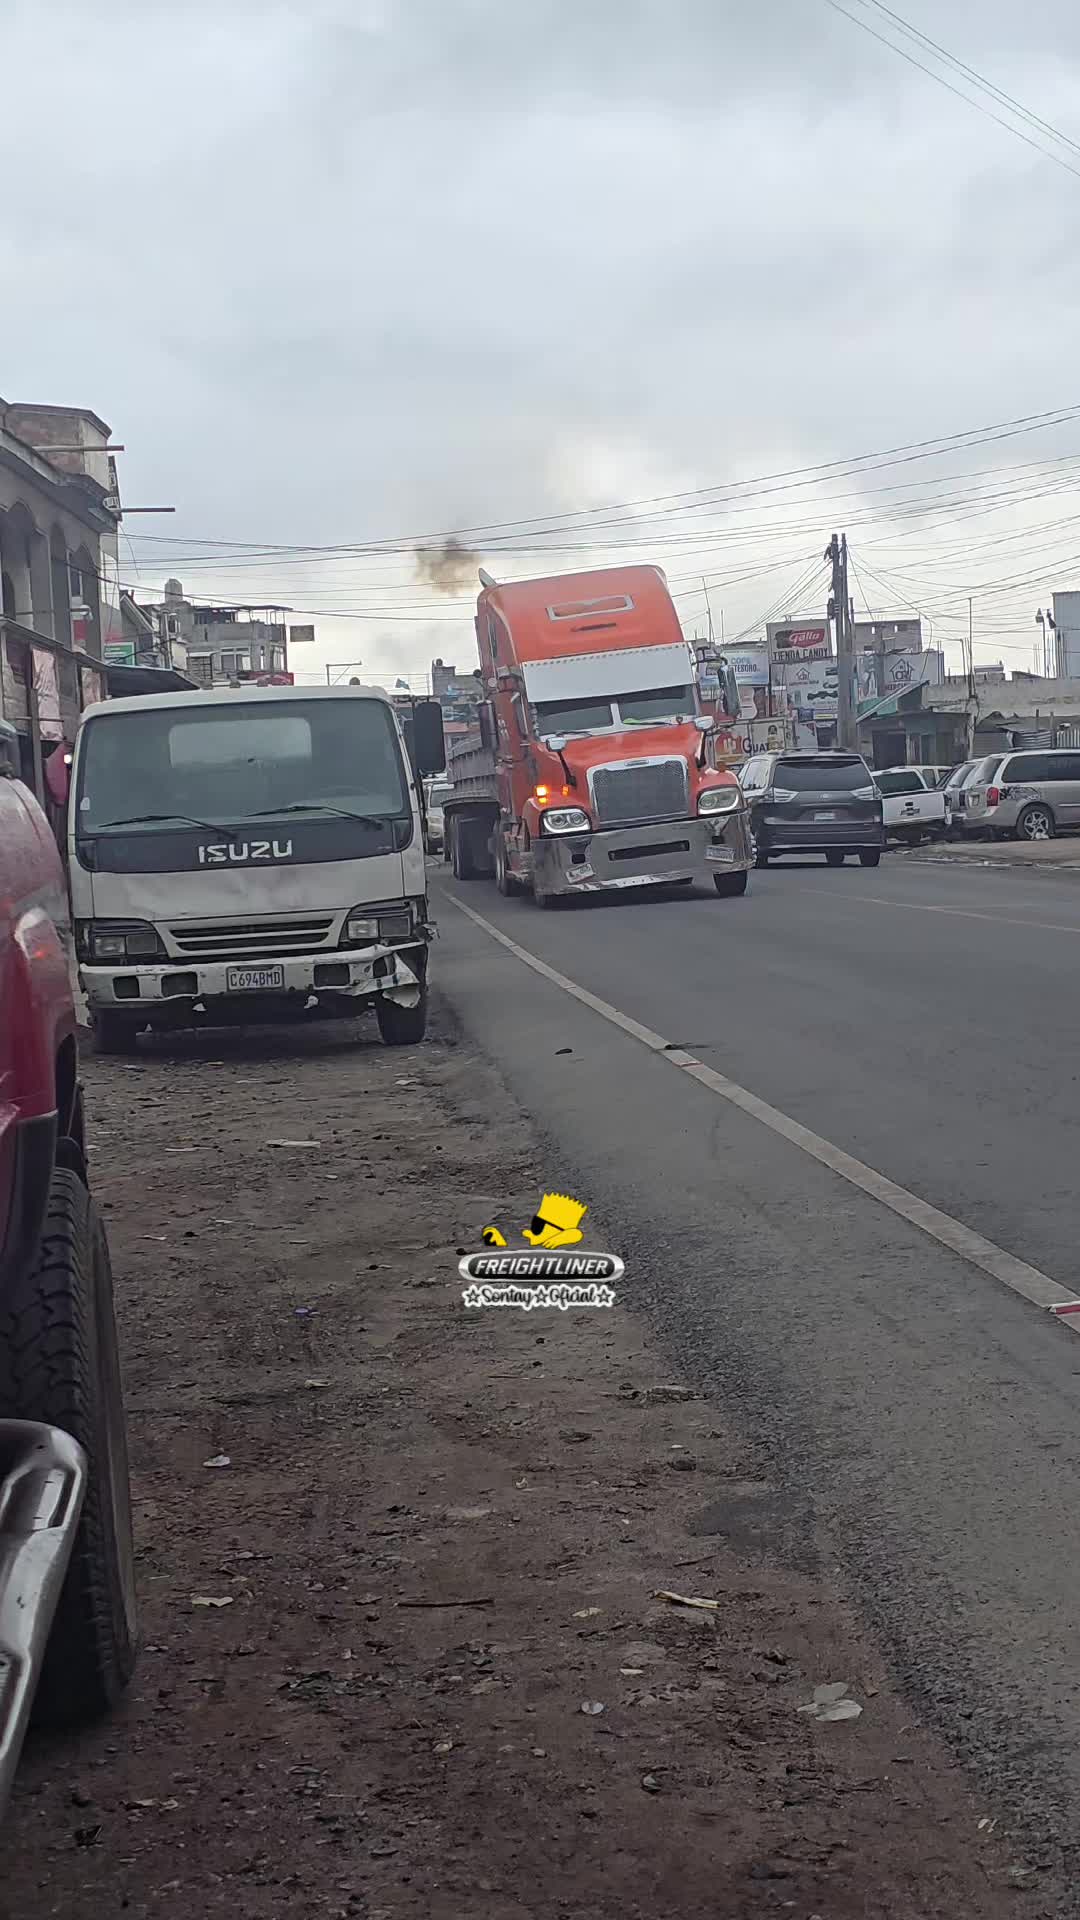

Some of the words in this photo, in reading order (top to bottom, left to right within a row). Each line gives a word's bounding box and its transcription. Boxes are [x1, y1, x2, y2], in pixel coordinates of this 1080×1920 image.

[773, 648, 800, 662] TIENDA
[802, 647, 828, 658] CANDY
[198, 839, 293, 864] ISUZU
[230, 971, 281, 987] C694BMD
